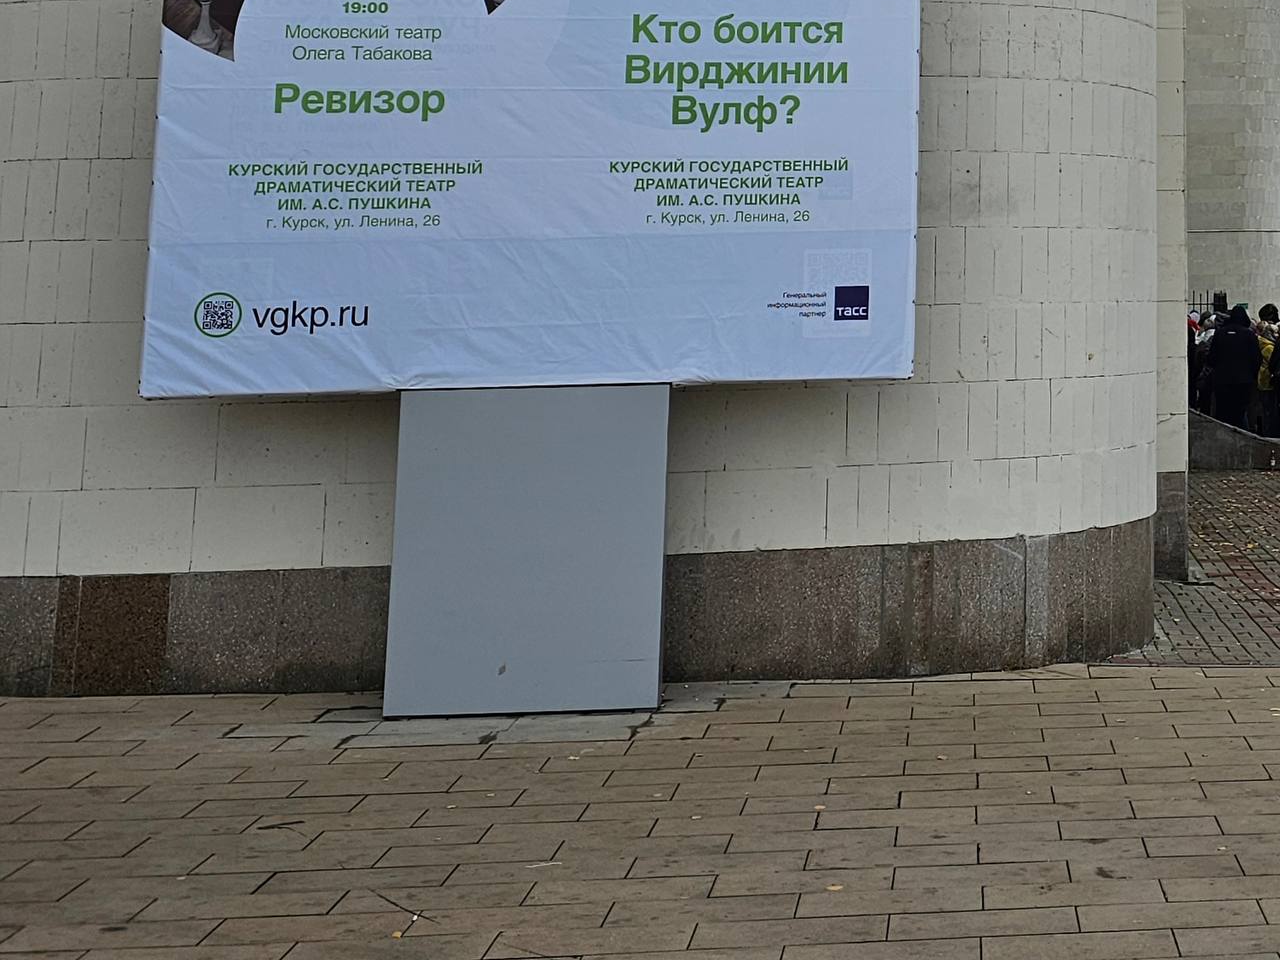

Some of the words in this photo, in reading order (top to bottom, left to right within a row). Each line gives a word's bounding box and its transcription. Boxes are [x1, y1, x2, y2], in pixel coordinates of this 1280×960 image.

[343, 2, 388, 13] 19:00
[286, 25, 388, 39] Московский
[395, 28, 441, 42] театр
[632, 14, 701, 43] Кто
[714, 14, 843, 43] боится
[293, 46, 344, 60] Олега
[352, 46, 432, 60] Табакова
[625, 55, 847, 92] Вирджинии
[275, 83, 445, 121] Ревизор
[671, 94, 801, 132] Вулф?
[229, 161, 307, 176] КУРСКИЙ
[314, 160, 482, 177] ГОСУДАРСТВЕННЫЙ
[610, 159, 684, 173] КУРСКИЙ
[690, 157, 848, 174] ГОСУДАРСТВЕННЫЙ
[254, 178, 400, 195] ДРАМАТИЧЕСКИЙ
[406, 180, 455, 191] ТЕАТР
[634, 176, 772, 193] ДРАМАТИЧЕСКИЙ
[777, 177, 823, 188] ТЕАТР
[278, 199, 306, 210] ИМ.
[312, 198, 342, 210] А.С.
[349, 198, 431, 209] ПУШКИНА
[657, 195, 683, 206] ИМ.
[689, 195, 717, 205] А.С.
[723, 194, 800, 205] ПУШКИНА
[267, 218, 276, 228] г.
[282, 216, 328, 231] Курск,
[335, 219, 353, 230] ул.
[359, 215, 417, 227] Ленина,
[423, 215, 440, 226] 26
[647, 215, 655, 223] г.
[661, 212, 705, 226] Курск,
[710, 214, 728, 225] ул.
[734, 211, 788, 223] Ленина,
[794, 210, 809, 221] 26
[767, 301, 827, 309] информационный
[836, 306, 867, 316] тасс
[253, 301, 368, 335] vgkp.ru
[799, 310, 826, 318] партнер
